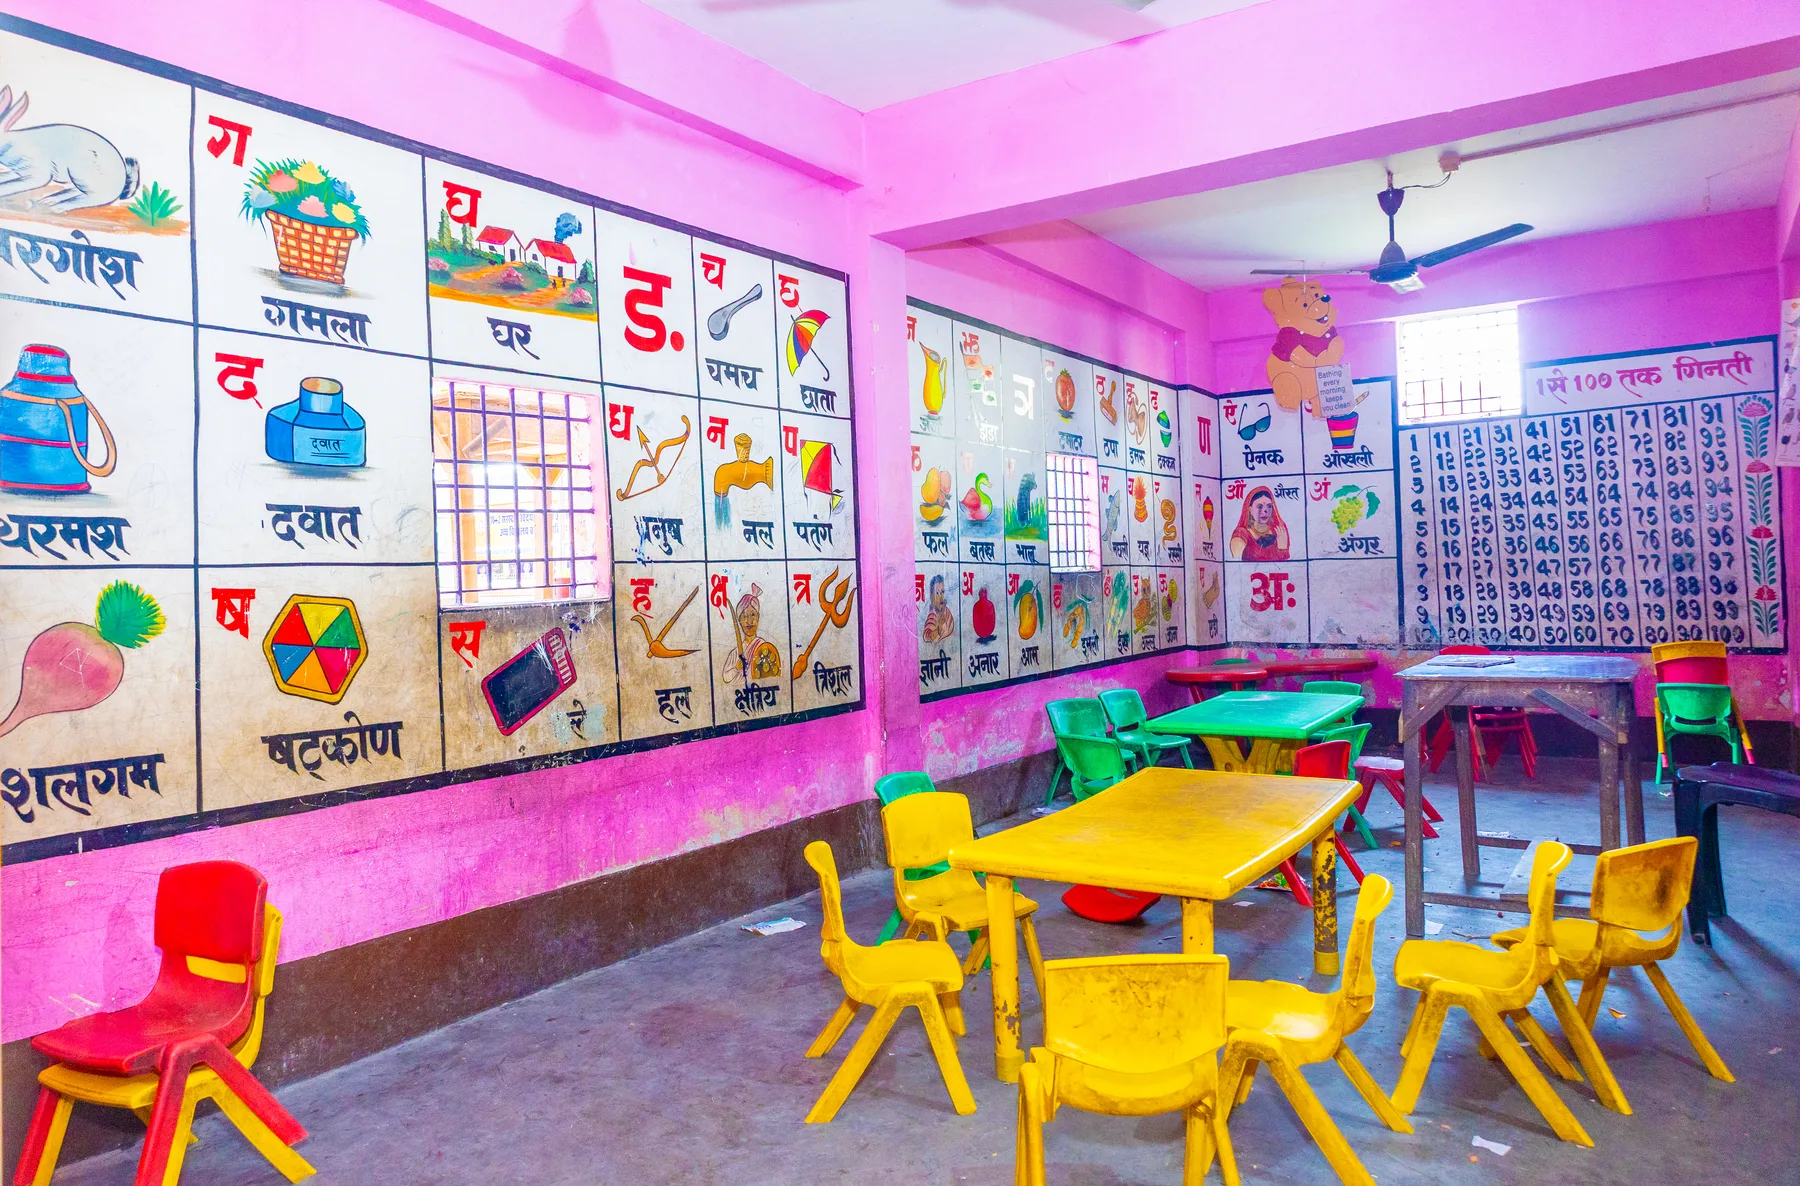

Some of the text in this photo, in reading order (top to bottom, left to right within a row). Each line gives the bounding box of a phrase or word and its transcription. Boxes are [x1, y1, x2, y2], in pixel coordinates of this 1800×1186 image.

[207, 115, 252, 167] ग
[442, 181, 482, 228] घ
[700, 253, 726, 289] च
[778, 274, 802, 312] छ
[261, 296, 371, 347] गमला
[486, 316, 539, 360] घर
[215, 353, 264, 409] द
[705, 357, 763, 391] चमच
[1318, 370, 1342, 379] Bathing
[1320, 386, 1345, 395] morning
[1536, 351, 1753, 405] 1 से 100 तक गिनती
[800, 384, 836, 413] छाता
[1223, 400, 1237, 425] ऐ
[609, 403, 634, 440] ध
[707, 416, 728, 449] न
[1197, 416, 1211, 455] ण
[1410, 434, 1418, 451] 1
[1434, 431, 1451, 449] 11
[1464, 426, 1482, 447] 21
[1493, 424, 1514, 443] 31
[1525, 421, 1548, 439] 41
[1561, 417, 1582, 436] 51
[1625, 409, 1652, 430] 71
[1664, 406, 1689, 427] 81
[1701, 403, 1723, 424] 91
[310, 437, 345, 453] दवात
[783, 425, 799, 456] प
[1242, 444, 1284, 470] ऐनक
[1410, 427, 1727, 473] 2 12 22 32 42 52 62 72 82 92
[1310, 477, 1331, 501] अं
[1411, 450, 1729, 494] 3 13 23 33 43 53 63 73 83 93
[1411, 476, 1733, 516] 4 14 24 34 44 54 64 74 84 94
[265, 504, 362, 549] दवात
[742, 520, 774, 549] नल
[793, 514, 833, 552] पतंग
[1416, 521, 1428, 537] 5
[1441, 519, 1461, 536] 15
[1471, 516, 1493, 534] 25
[1503, 515, 1526, 532] 35
[1532, 513, 1558, 532] 45
[1567, 511, 1590, 529] 55
[1599, 507, 1622, 527] 65
[1633, 507, 1658, 526] 75
[1670, 504, 1695, 524] 85
[922, 532, 949, 557] फल
[1338, 533, 1383, 554] अंगूर
[1416, 525, 1735, 558] 6 16 26 36 46 56 66 76 86 96
[1417, 552, 1734, 580] 7 17 27 37 47 57 67 77 87 97
[631, 579, 654, 618] ह
[711, 574, 728, 619] क्ष
[793, 574, 811, 604] त्र
[962, 572, 974, 596] अ
[1008, 573, 1020, 595] आ
[212, 588, 256, 639] ष
[449, 621, 486, 667] स
[1021, 646, 1039, 666] आम
[969, 652, 1000, 677] अनार
[654, 687, 692, 722] हल
[1, 754, 165, 823] शलगम
